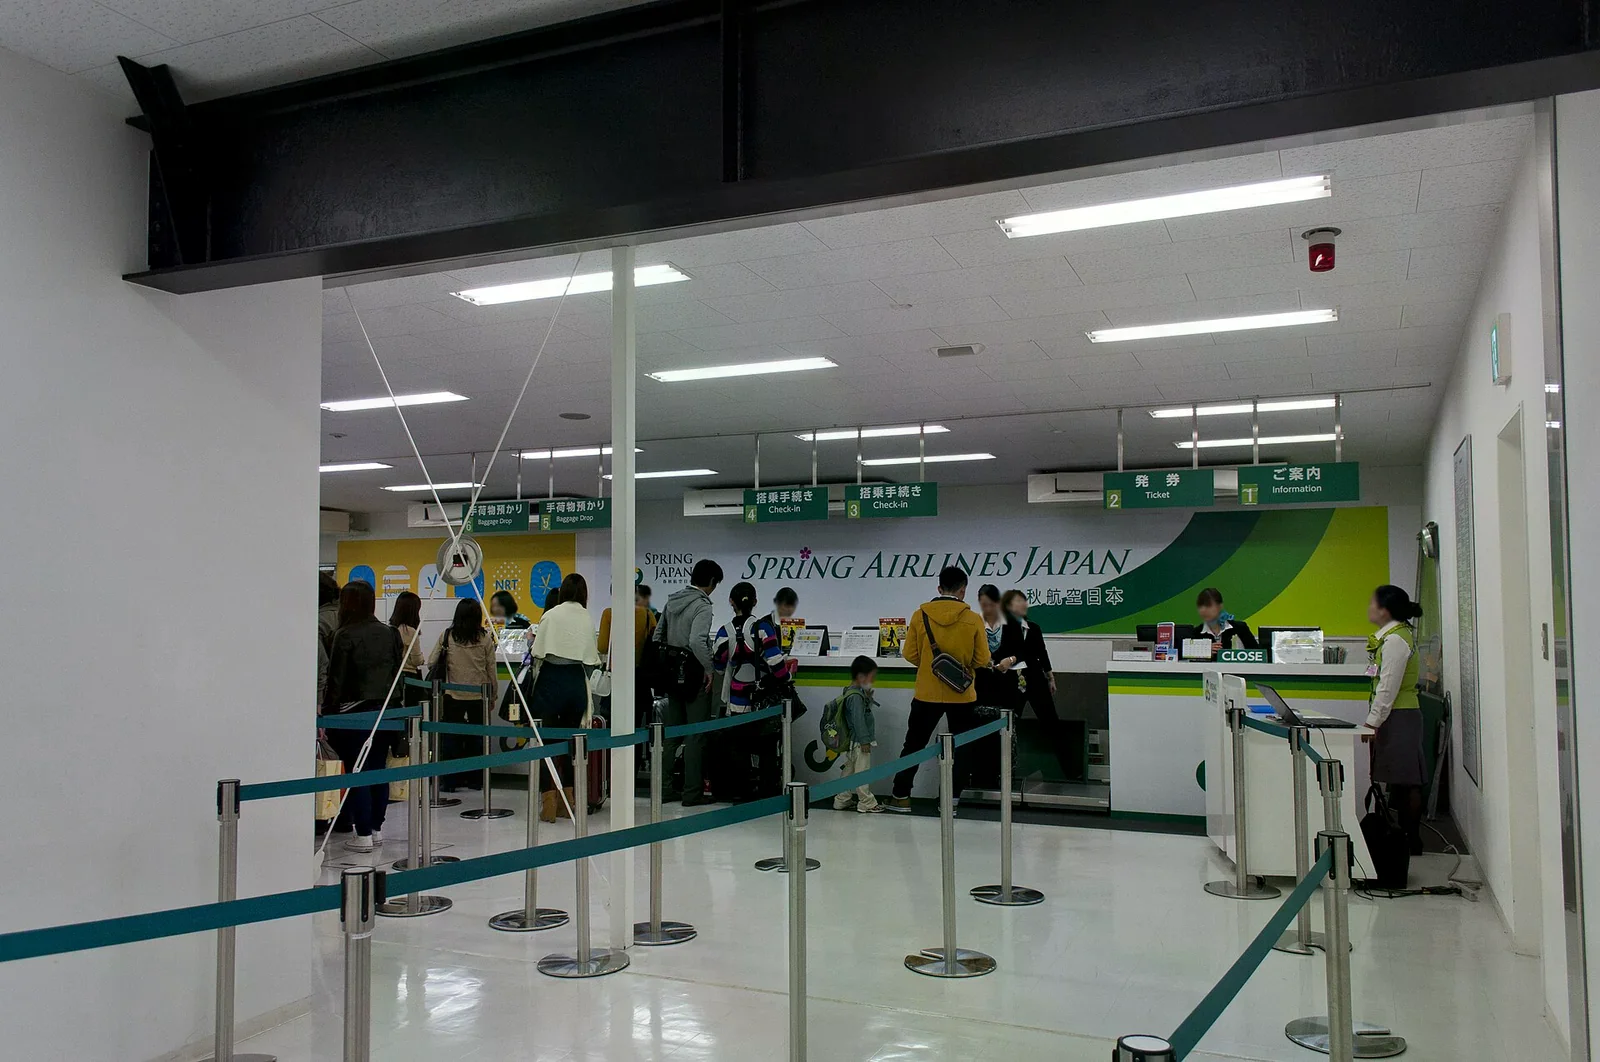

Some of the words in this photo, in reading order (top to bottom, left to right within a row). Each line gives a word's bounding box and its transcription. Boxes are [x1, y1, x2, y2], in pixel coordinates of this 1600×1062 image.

[1273, 466, 1322, 482] ご案内
[859, 485, 922, 499] 搭乗手続き
[1145, 491, 1170, 499] Ticket
[1272, 484, 1322, 494] Information
[756, 491, 814, 505] 搭乗手続き
[873, 499, 909, 510] Check-in
[1109, 494, 1119, 508] 2
[469, 503, 523, 517] 手荷物預かり
[546, 500, 605, 513] 手荷物預かり
[769, 504, 801, 514] Check-in
[850, 504, 858, 517] 3
[556, 515, 579, 524] Baggage
[580, 514, 594, 522] Drop
[748, 508, 756, 521] 4
[465, 520, 472, 532] 6
[477, 518, 498, 527] Baggage
[499, 517, 513, 525] Drop
[543, 517, 549, 529] 5
[645, 552, 693, 565] SPRING
[741, 550, 856, 580] SPRING
[859, 550, 1018, 579] AIRLINES
[1014, 546, 1132, 584] JAPAN
[654, 566, 693, 581] JAPAN
[495, 579, 519, 591] NRT
[1019, 586, 1124, 606] 秋航空日本
[1221, 651, 1263, 662] CLOSE
